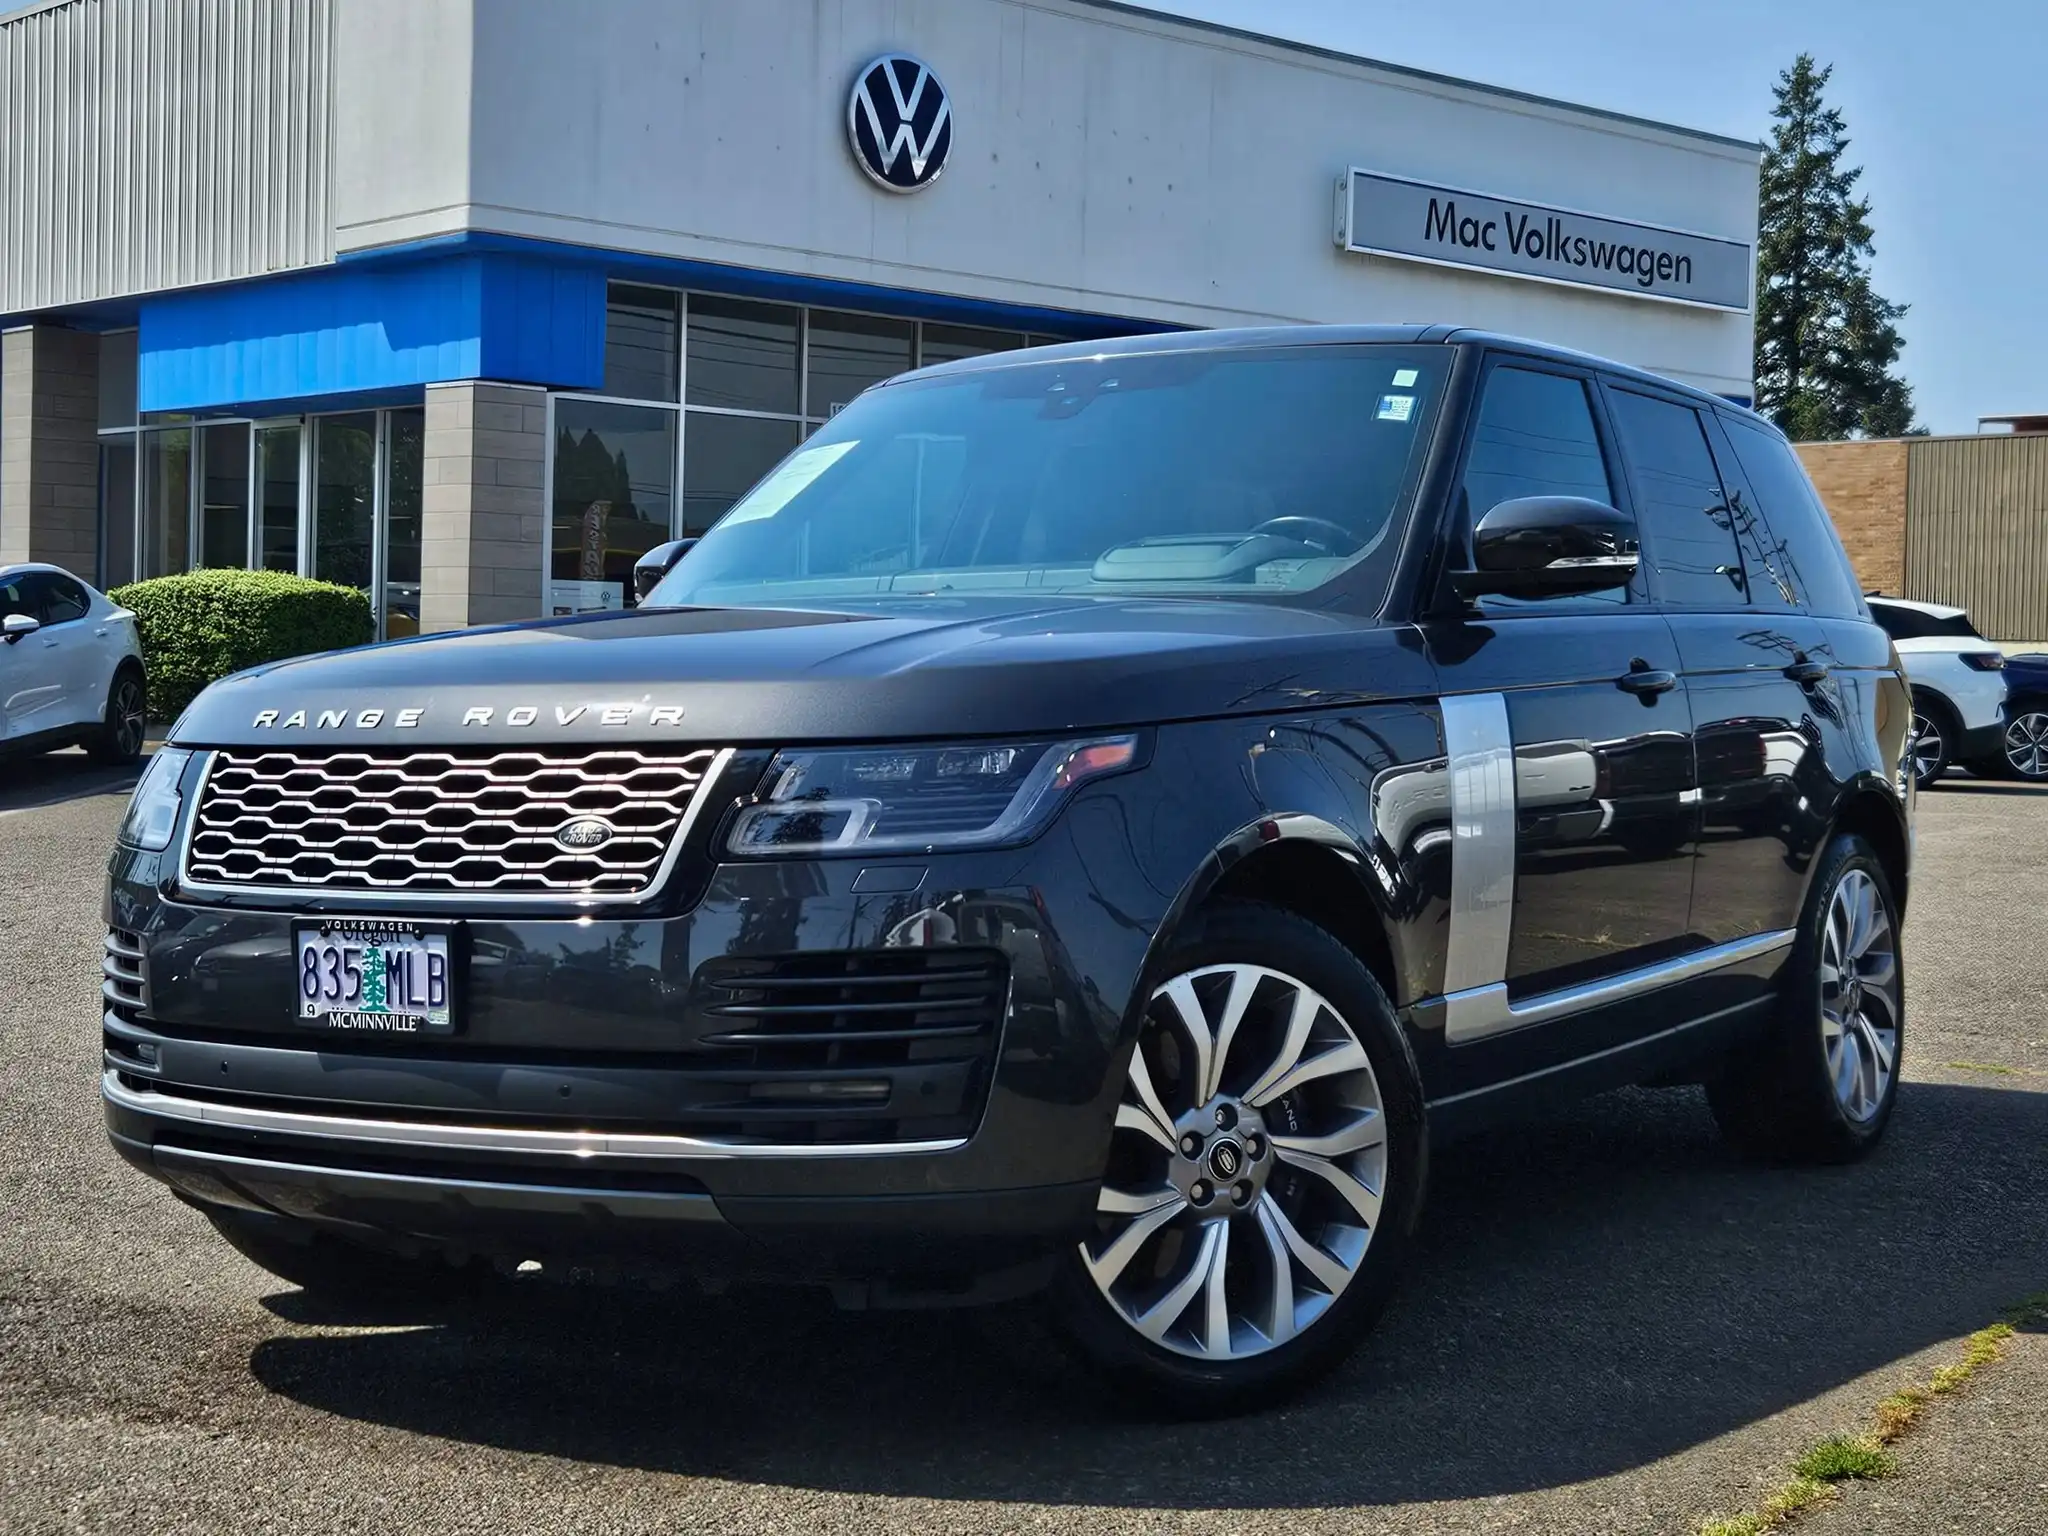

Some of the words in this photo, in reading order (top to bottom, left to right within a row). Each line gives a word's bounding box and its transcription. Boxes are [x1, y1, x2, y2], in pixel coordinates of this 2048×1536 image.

[853, 54, 951, 182] VW
[1424, 198, 1496, 251] Mac
[1504, 212, 1691, 287] Volkswagen
[253, 708, 425, 729] RANGE
[462, 705, 685, 727] ROVER
[569, 833, 602, 843] ROVER
[326, 920, 413, 932] VOLKSWAGEN
[303, 946, 362, 1001] 835
[385, 949, 446, 1007] MLB
[329, 1012, 417, 1032] MCMINNVILLE
[1281, 1096, 1297, 1131] AND
